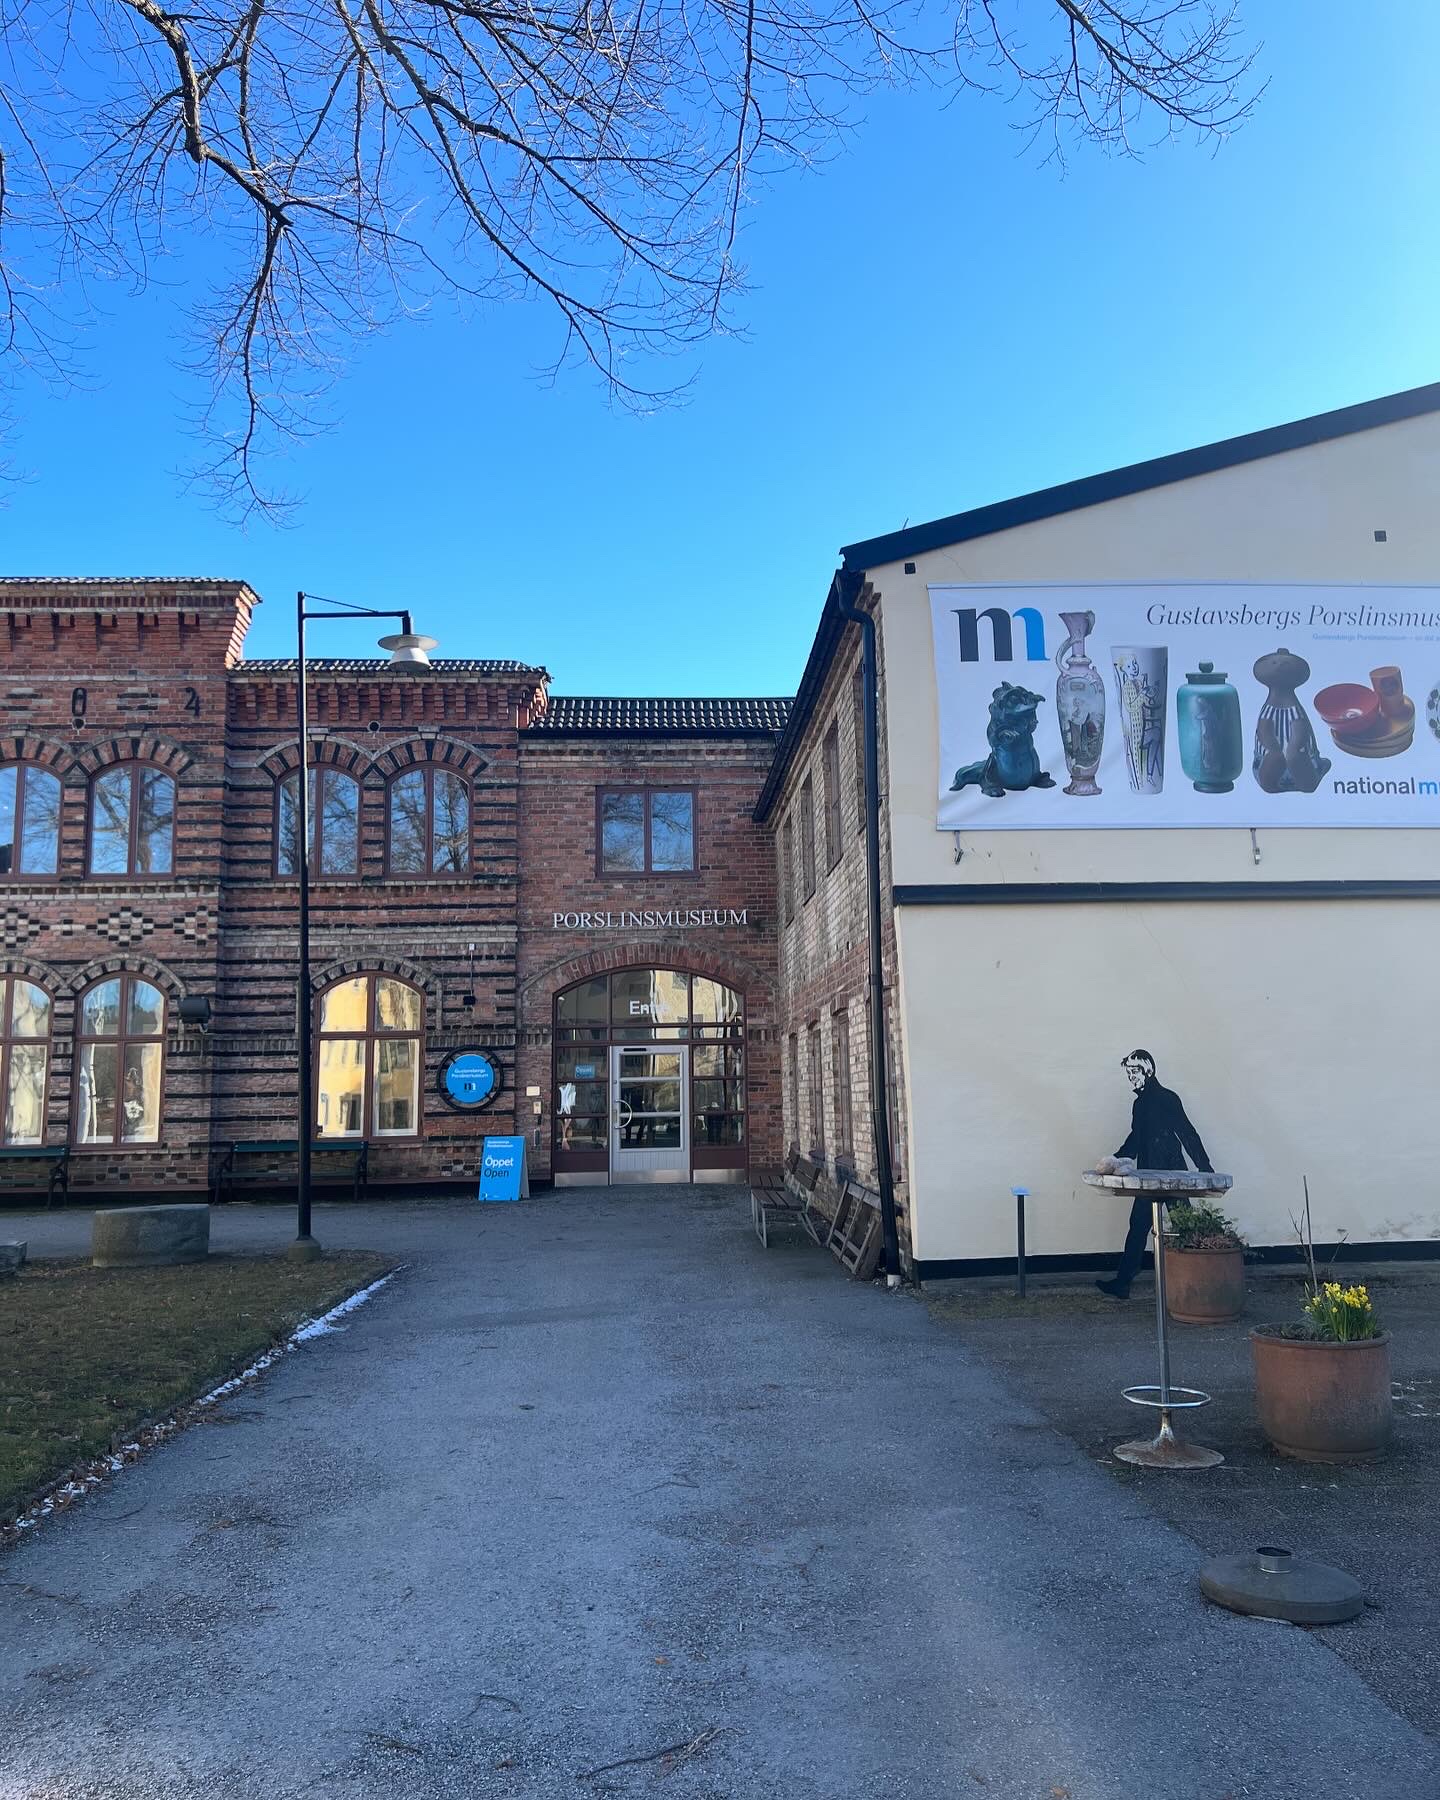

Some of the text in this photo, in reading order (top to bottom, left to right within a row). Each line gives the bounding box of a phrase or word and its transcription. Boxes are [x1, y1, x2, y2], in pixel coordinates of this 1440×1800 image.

[1146, 603, 1301, 631] Gustavsbergs
[1333, 776, 1440, 795] nationalm
[552, 909, 749, 929] PORSLINSMUSEUM
[484, 1155, 514, 1168] Öppet
[483, 1168, 510, 1178] Open
